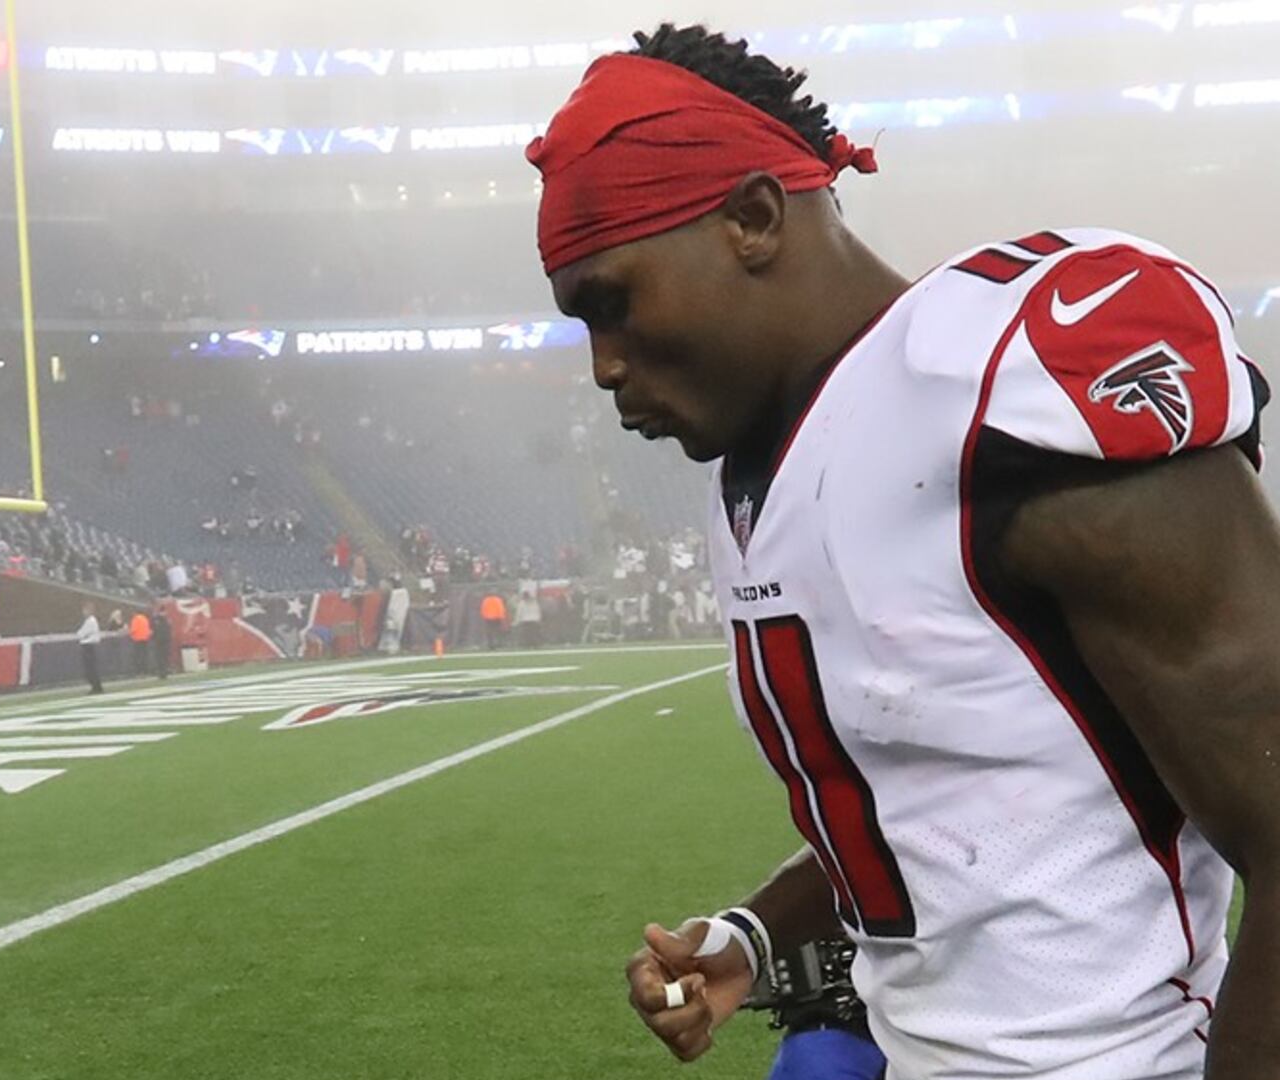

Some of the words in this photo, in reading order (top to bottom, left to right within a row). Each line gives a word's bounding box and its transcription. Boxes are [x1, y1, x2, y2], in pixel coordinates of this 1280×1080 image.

[296, 329, 426, 353] PATRIOTS
[427, 328, 484, 350] WIN
[730, 613, 917, 938] 11
